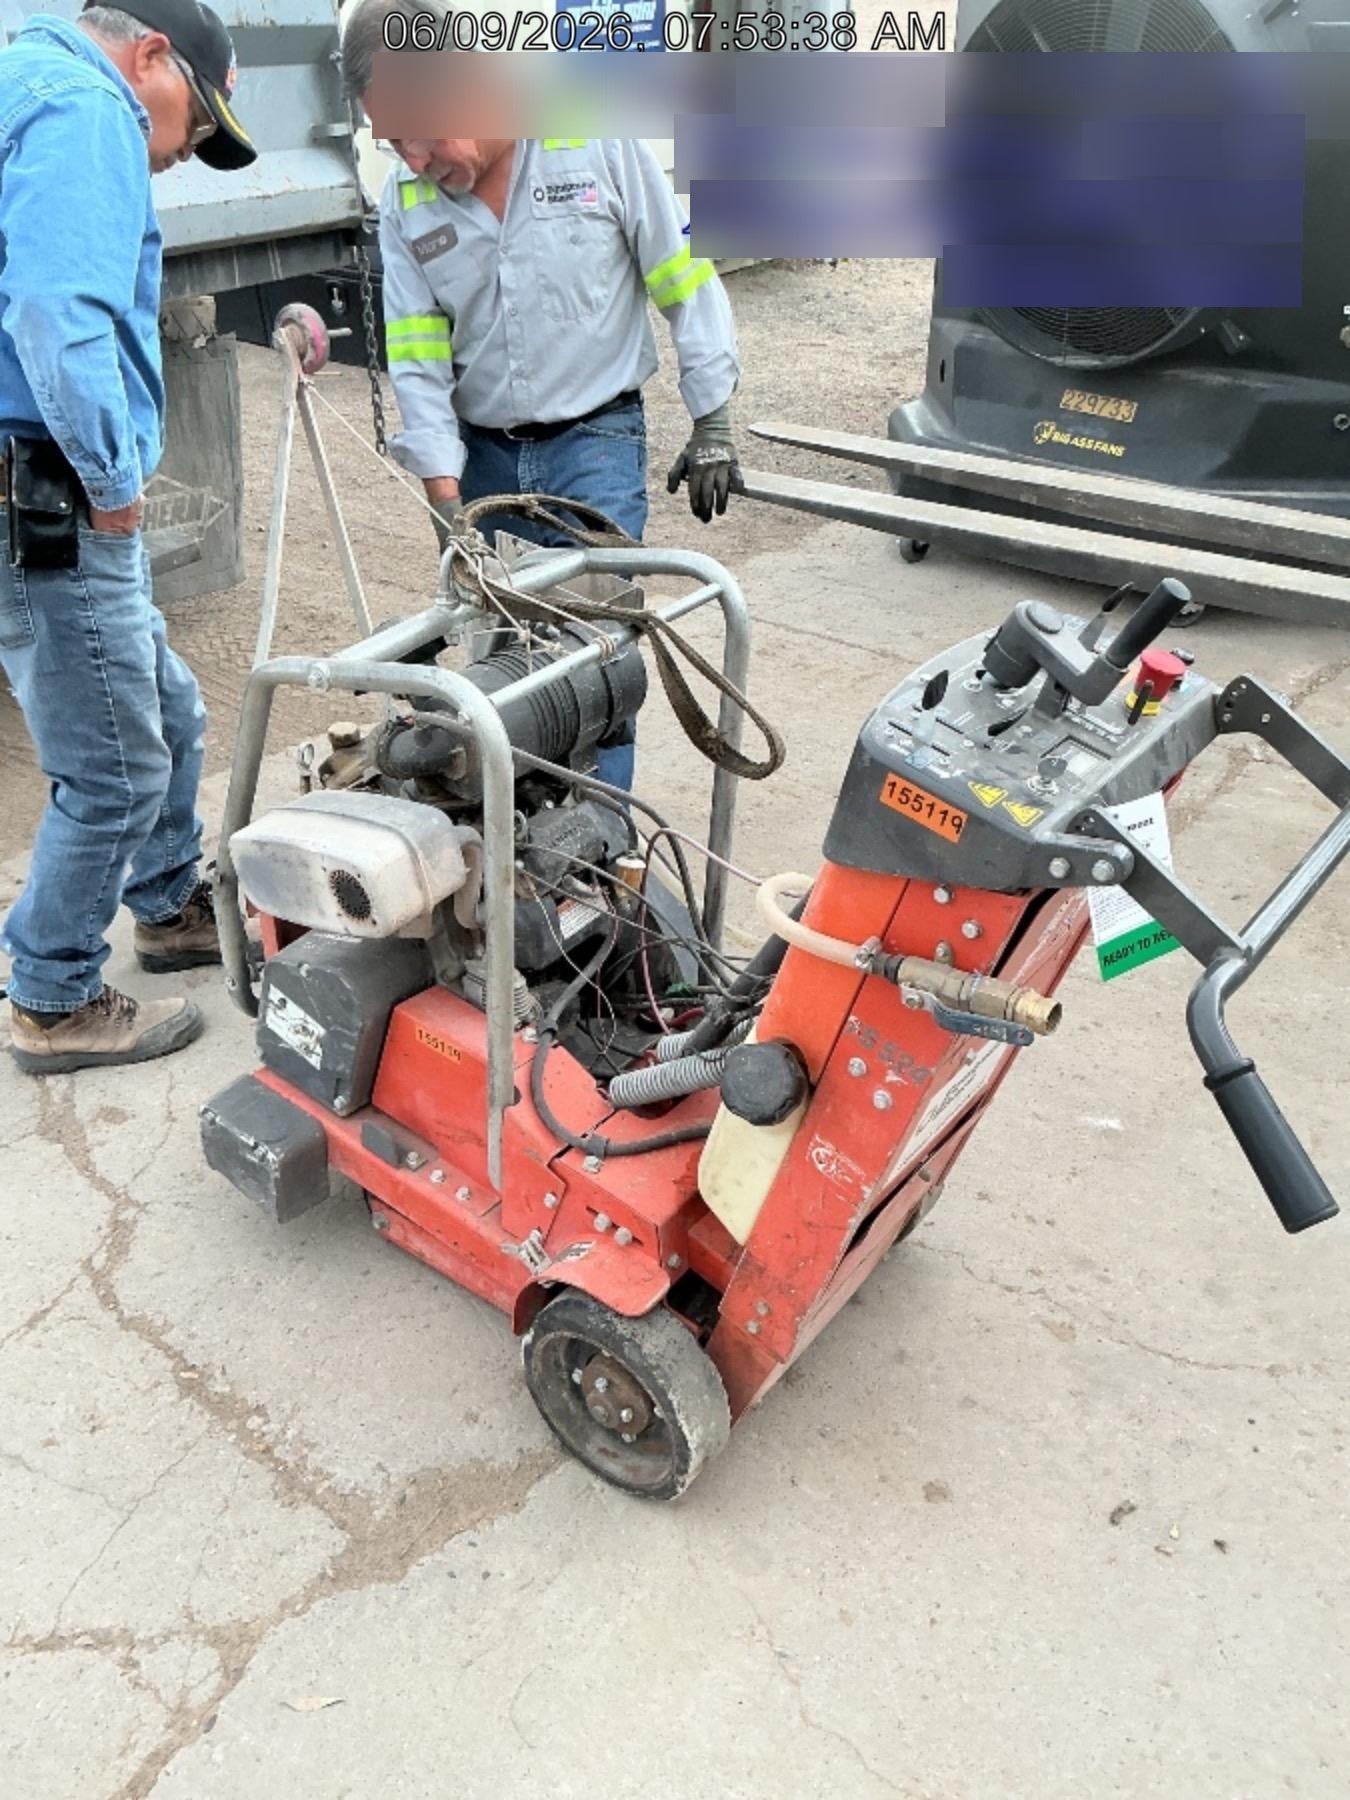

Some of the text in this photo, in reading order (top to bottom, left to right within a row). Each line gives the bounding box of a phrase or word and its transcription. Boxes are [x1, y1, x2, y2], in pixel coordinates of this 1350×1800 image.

[1062, 390, 1134, 420] 229733
[1092, 441, 1127, 457] FANS
[887, 781, 963, 835] 155119
[1103, 943, 1136, 967] READY
[1137, 936, 1151, 951] TO
